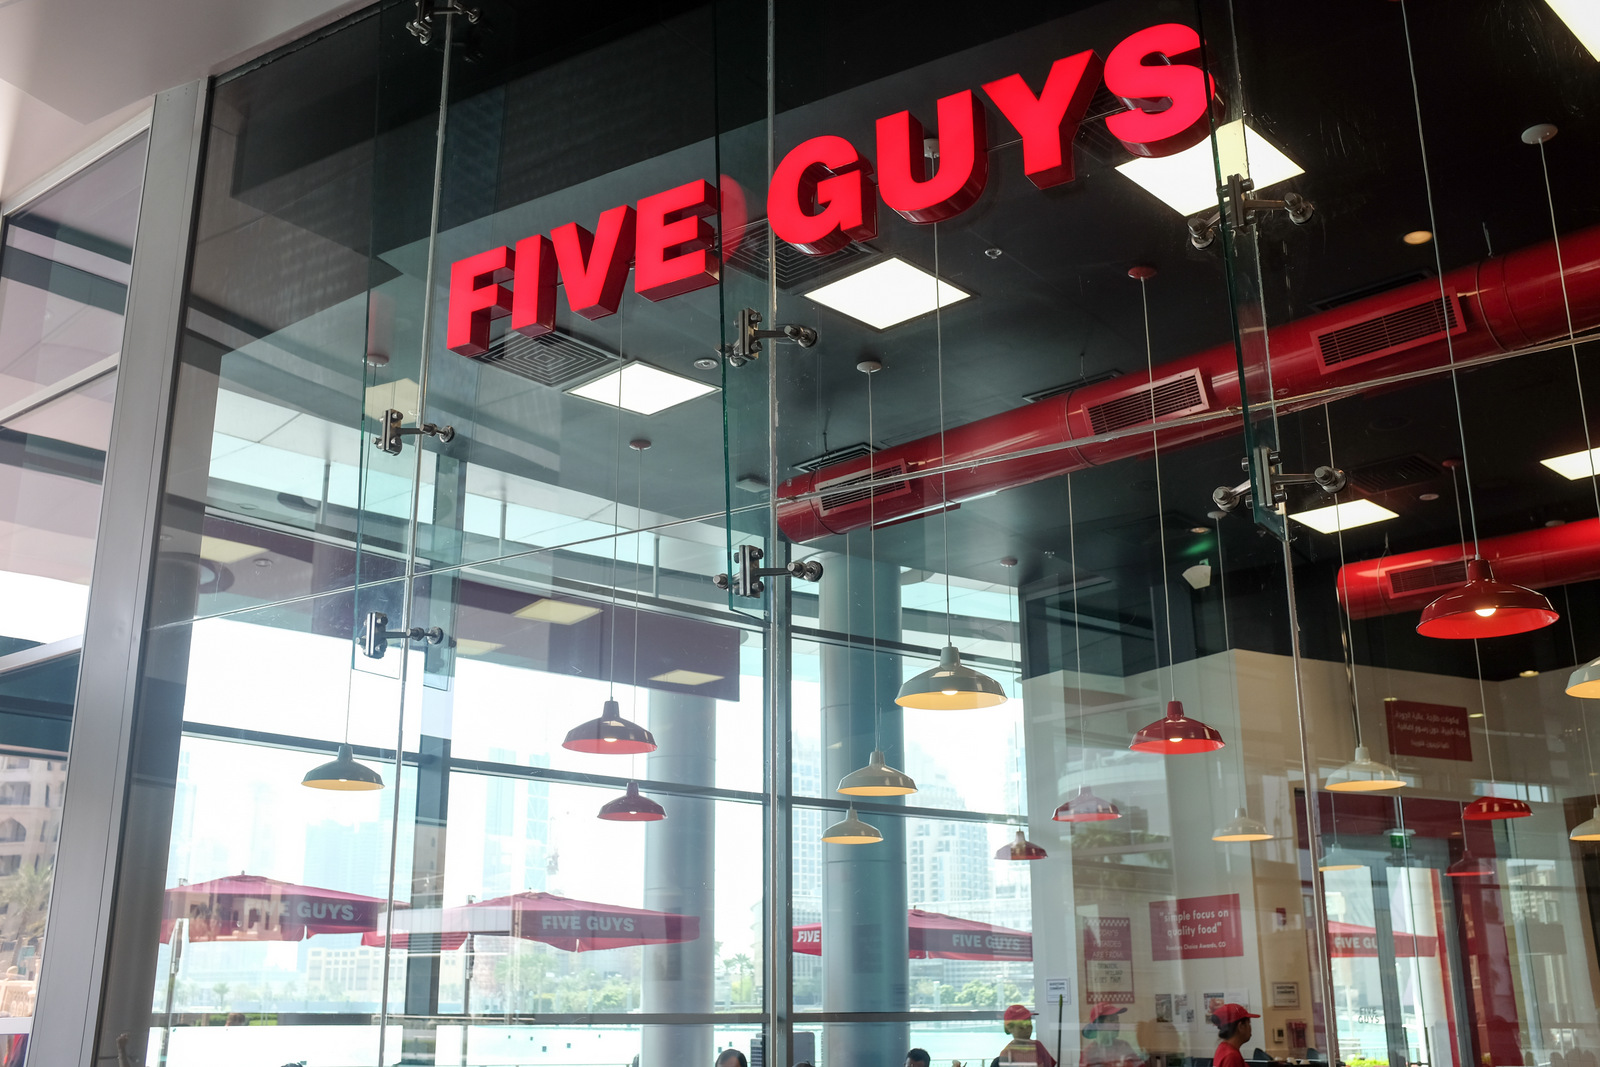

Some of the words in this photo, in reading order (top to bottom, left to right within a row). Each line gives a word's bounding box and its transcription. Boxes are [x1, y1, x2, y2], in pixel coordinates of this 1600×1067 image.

[446, 178, 721, 358] FIVE
[766, 22, 1225, 257] GUYS
[296, 901, 354, 921] GUYS
[1193, 909, 1215, 920] focus
[1217, 909, 1229, 918] on
[541, 915, 581, 930] FIVE
[586, 916, 635, 932] GUYS
[797, 930, 820, 943] FIVE
[1167, 925, 1196, 938] quality
[952, 934, 982, 948] FIVE
[985, 935, 1021, 951] GUYS
[1334, 936, 1361, 949] FIVE
[1359, 1006, 1377, 1015] FIVE
[1358, 1015, 1380, 1024] GUYS
